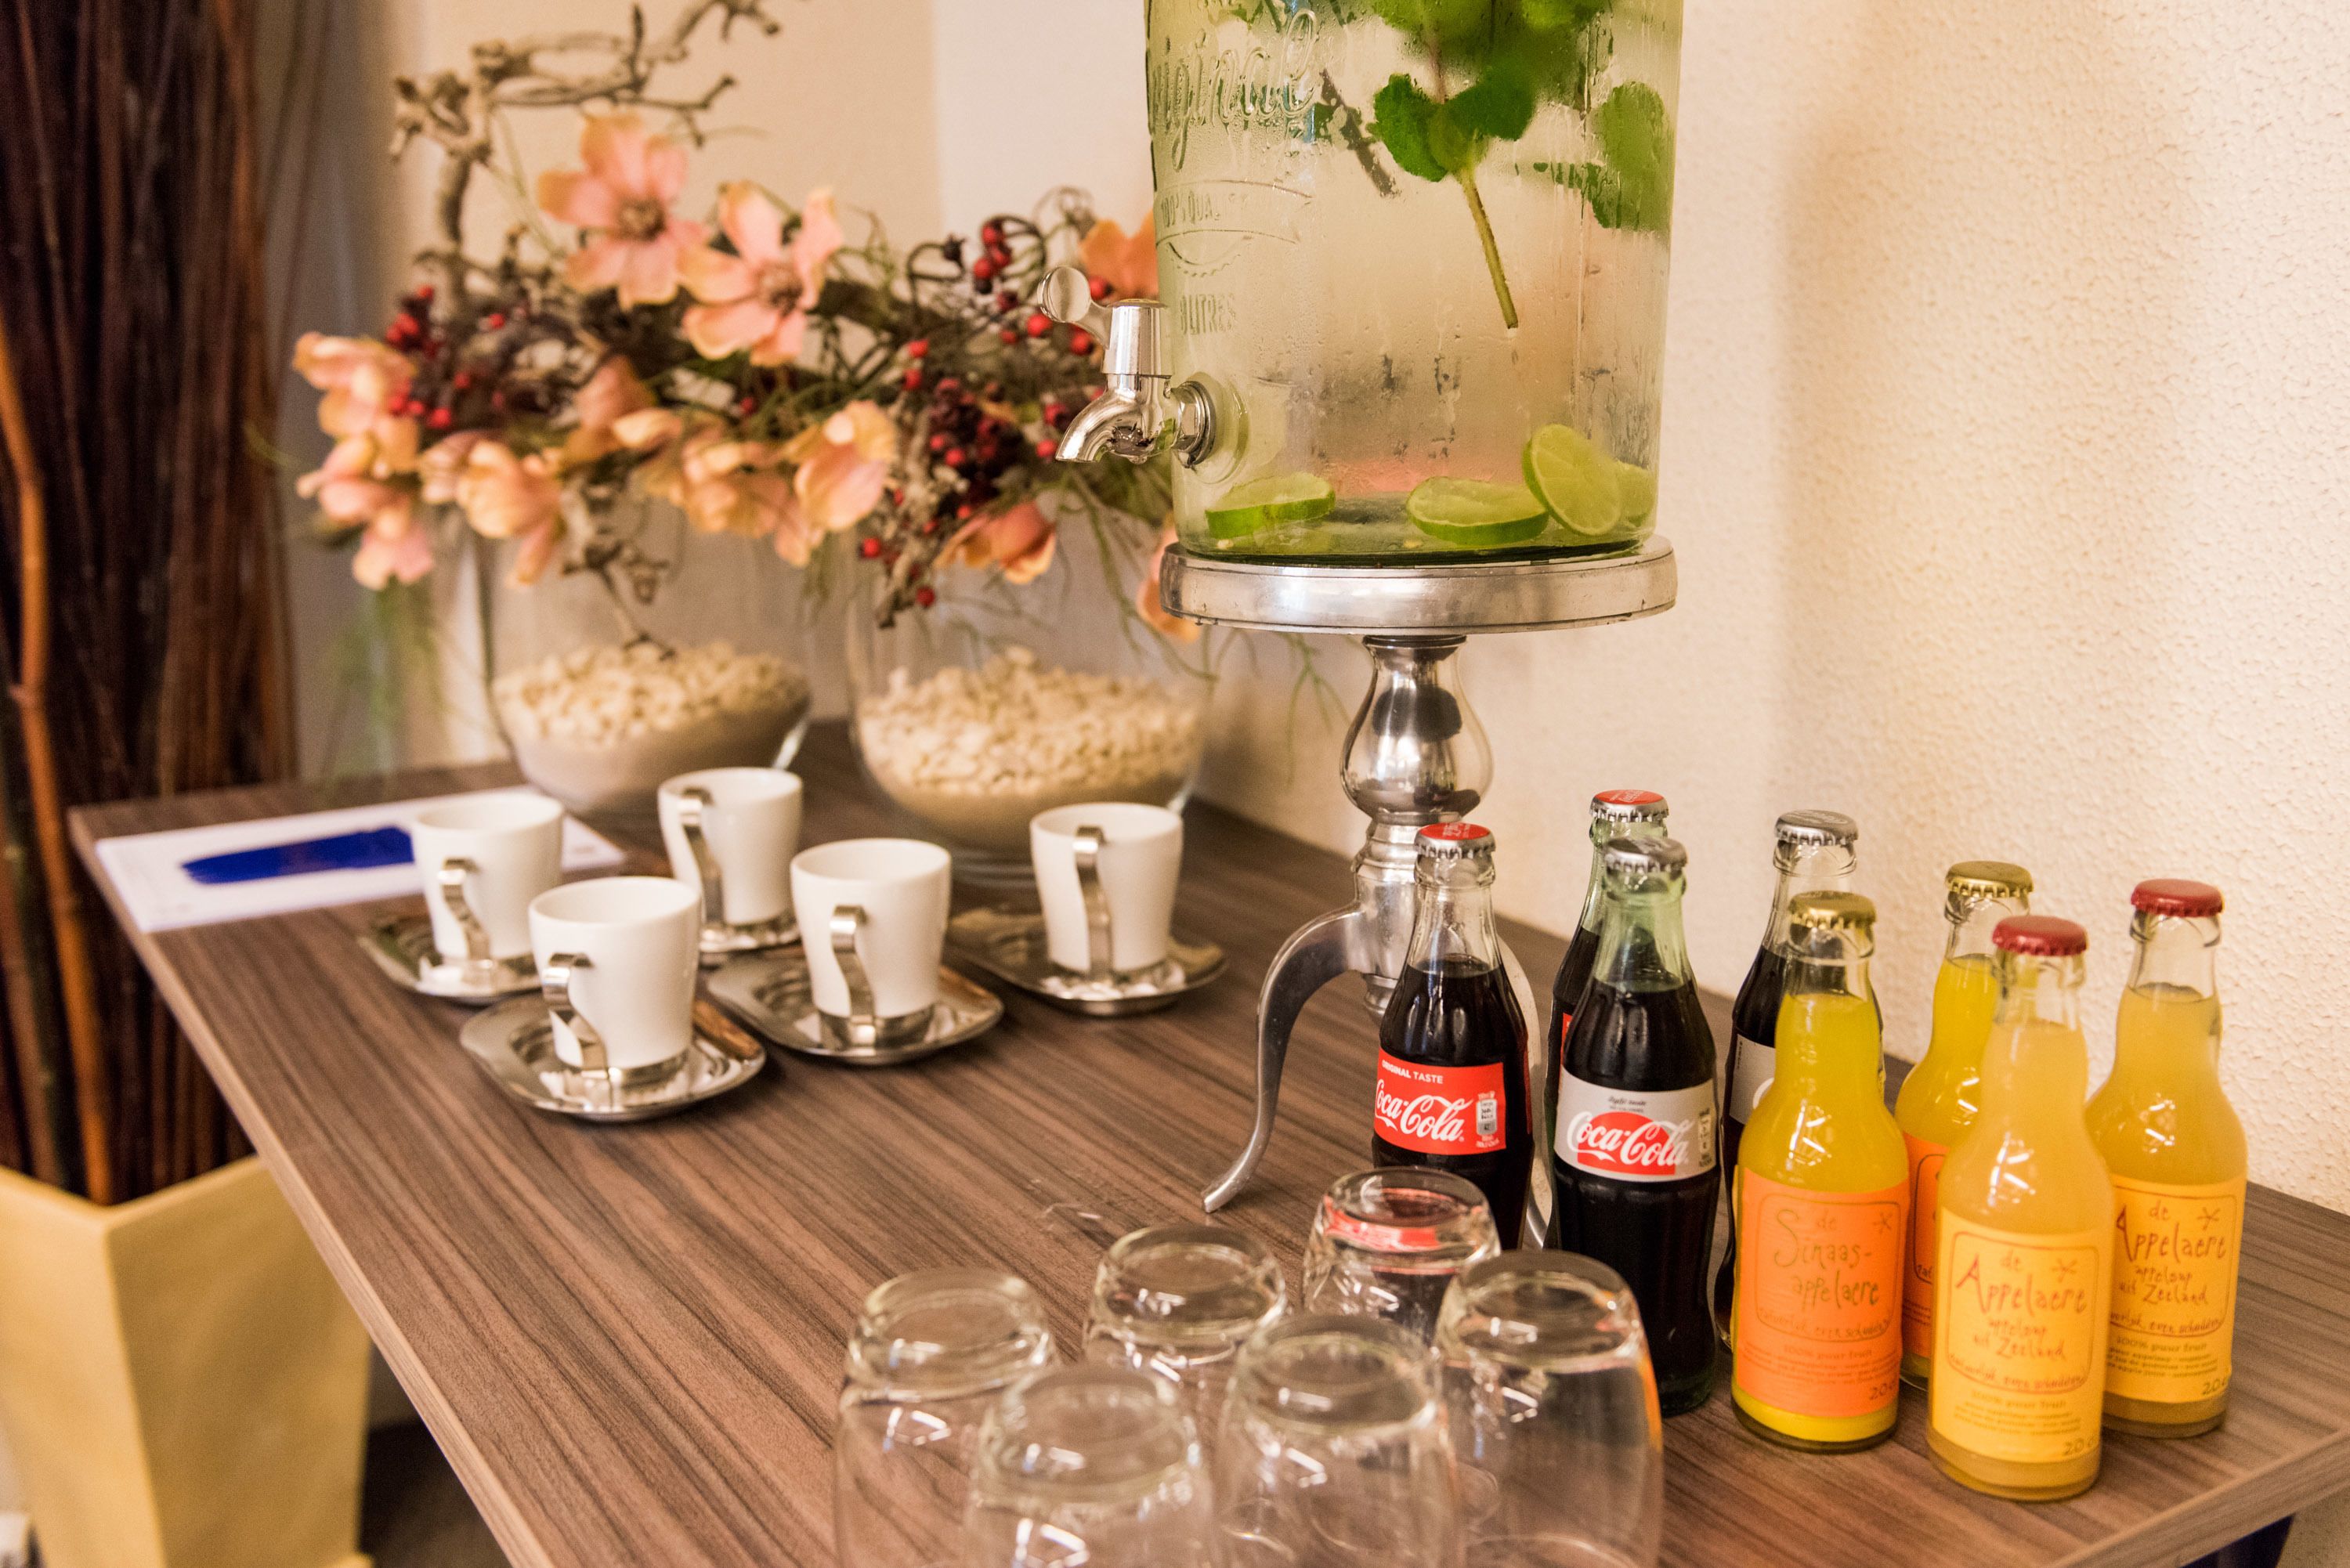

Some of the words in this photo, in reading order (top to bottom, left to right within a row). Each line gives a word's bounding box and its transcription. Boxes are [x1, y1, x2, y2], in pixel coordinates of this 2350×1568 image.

[1381, 1059, 1411, 1078] ORIGINAL
[1413, 1071, 1444, 1085] TASTE
[1375, 1078, 1473, 1143] Coca-Cola
[1567, 1111, 1695, 1167] Coca-Cola
[2149, 1199, 2170, 1222] de
[2000, 1249, 2023, 1274] de
[1955, 1252, 2088, 1318] Appelaere
